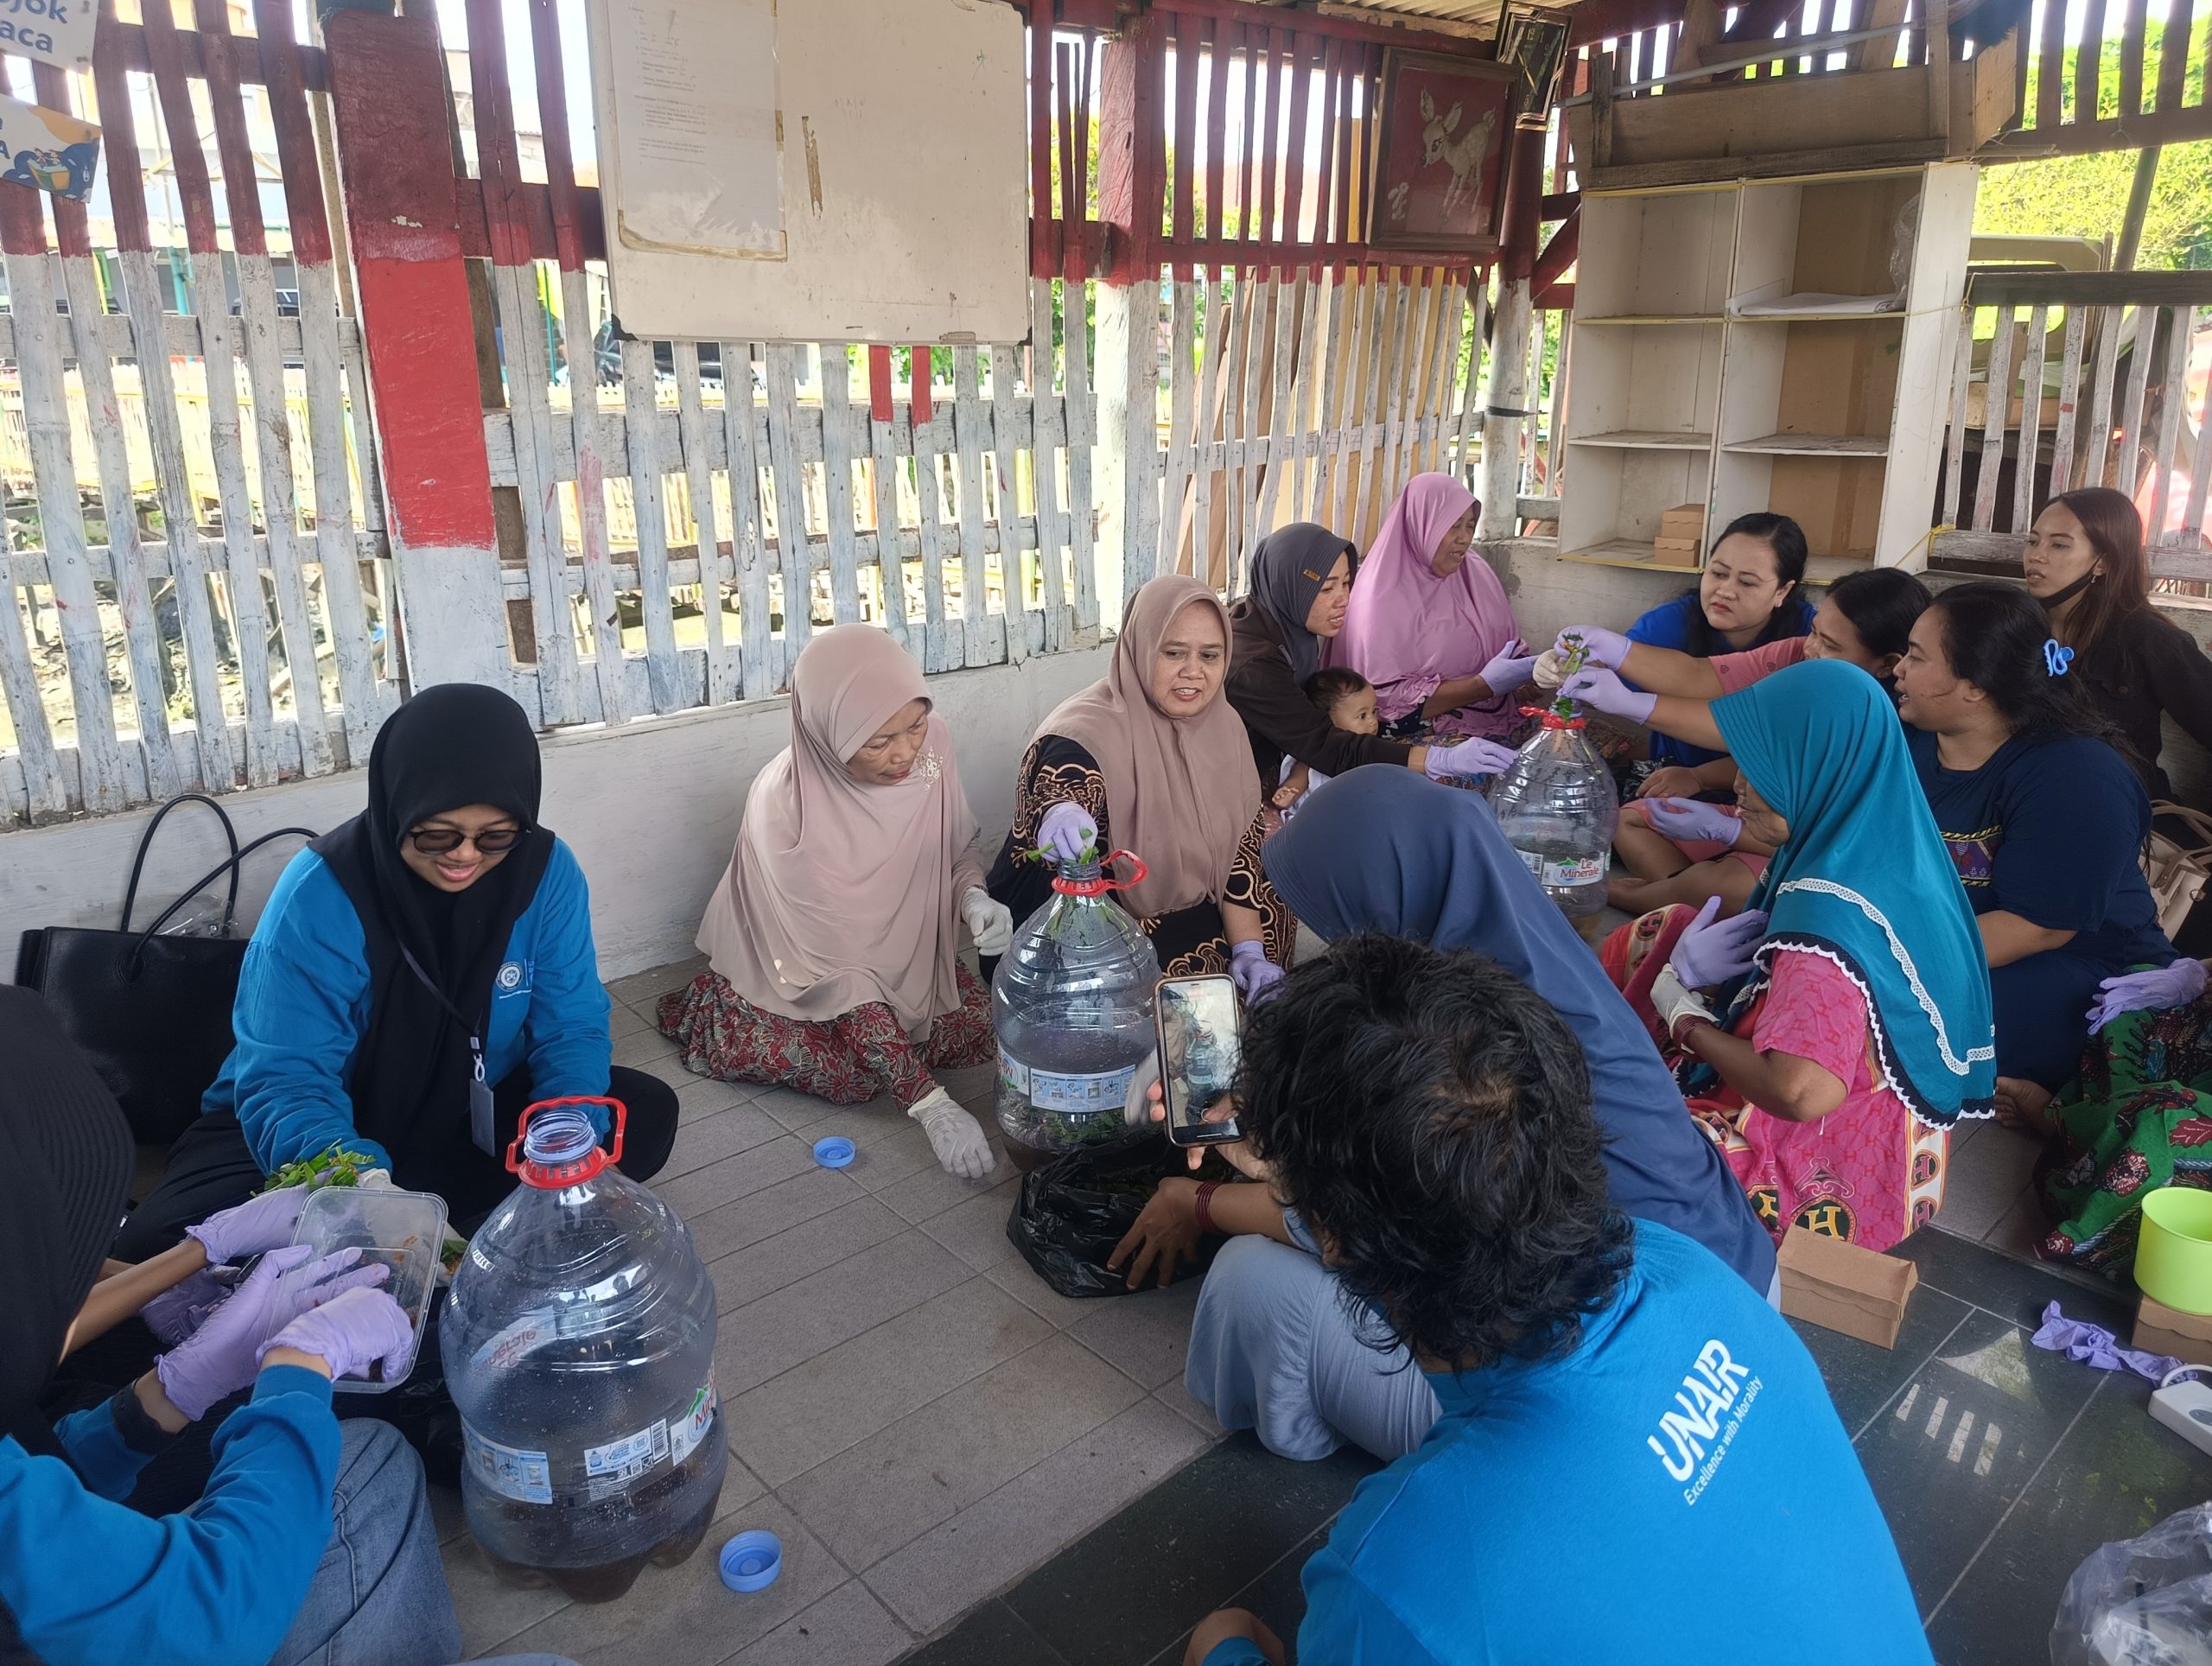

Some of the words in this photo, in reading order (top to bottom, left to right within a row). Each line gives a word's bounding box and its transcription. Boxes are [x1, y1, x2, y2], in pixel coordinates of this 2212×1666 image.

[0, 0, 67, 24] jok
[1560, 867, 1599, 879] Minerale
[1581, 858, 1592, 869] Le
[1647, 1339, 1750, 1482] UNAIR
[1683, 1445, 1726, 1506] Excellence
[1722, 1420, 1739, 1447] with
[1732, 1376, 1764, 1422] Morality
